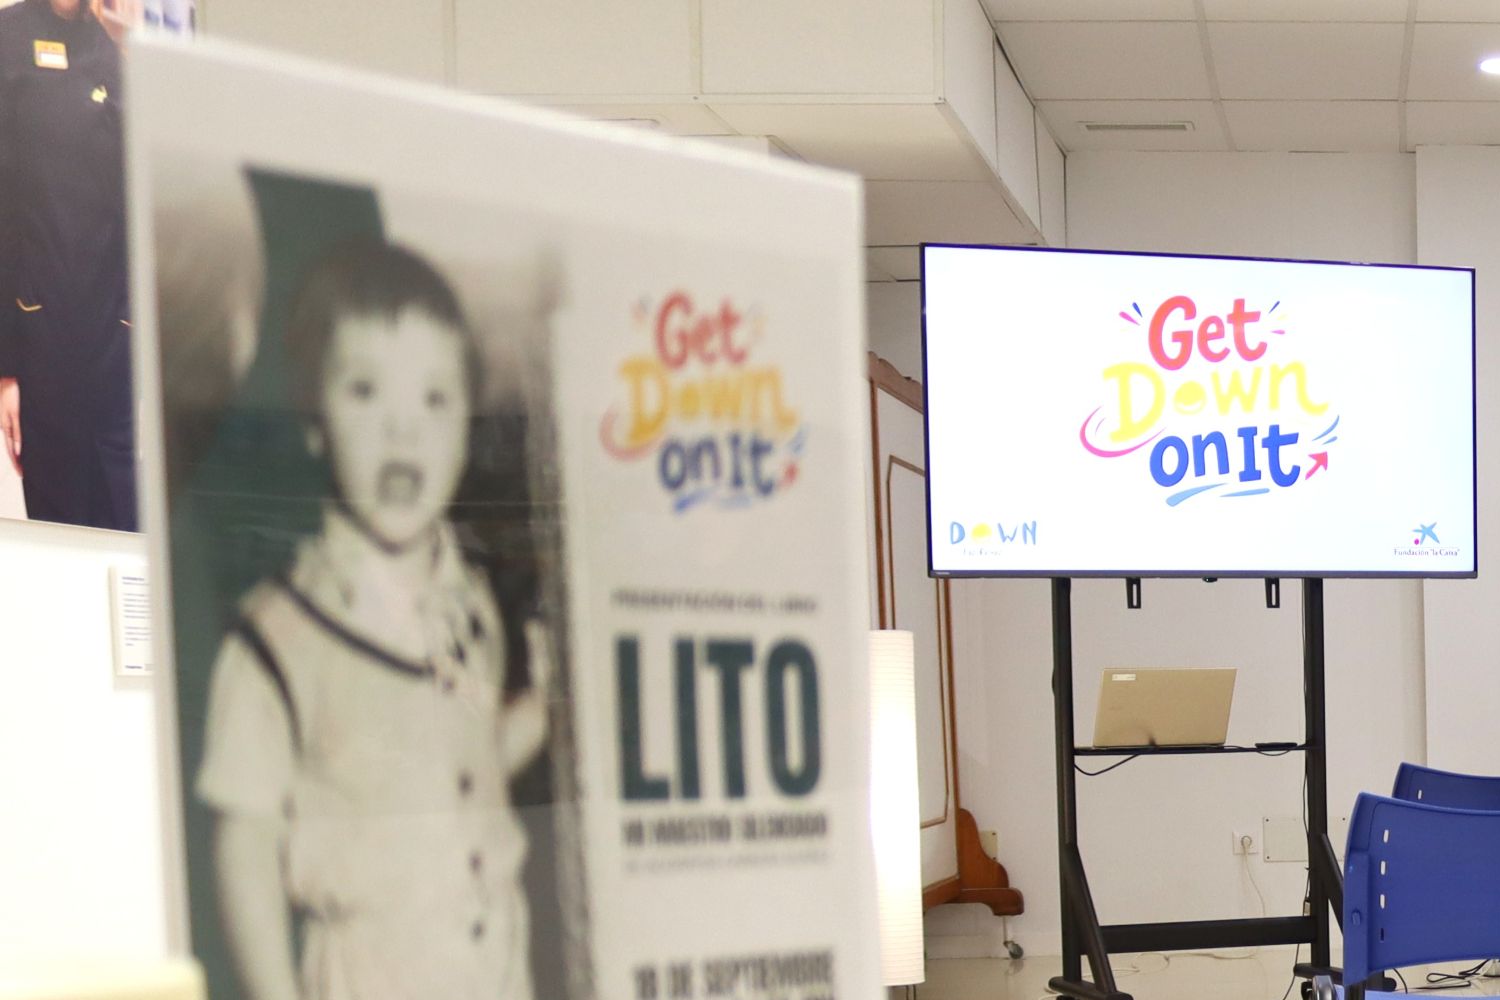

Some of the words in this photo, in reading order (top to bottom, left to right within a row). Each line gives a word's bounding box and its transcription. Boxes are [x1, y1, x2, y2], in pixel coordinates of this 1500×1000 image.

[654, 291, 748, 370] Get
[1148, 295, 1267, 370] Get
[620, 357, 796, 448] Down
[1102, 360, 1329, 442] Down
[949, 520, 1037, 545] DOWN
[615, 634, 821, 802] LITO
